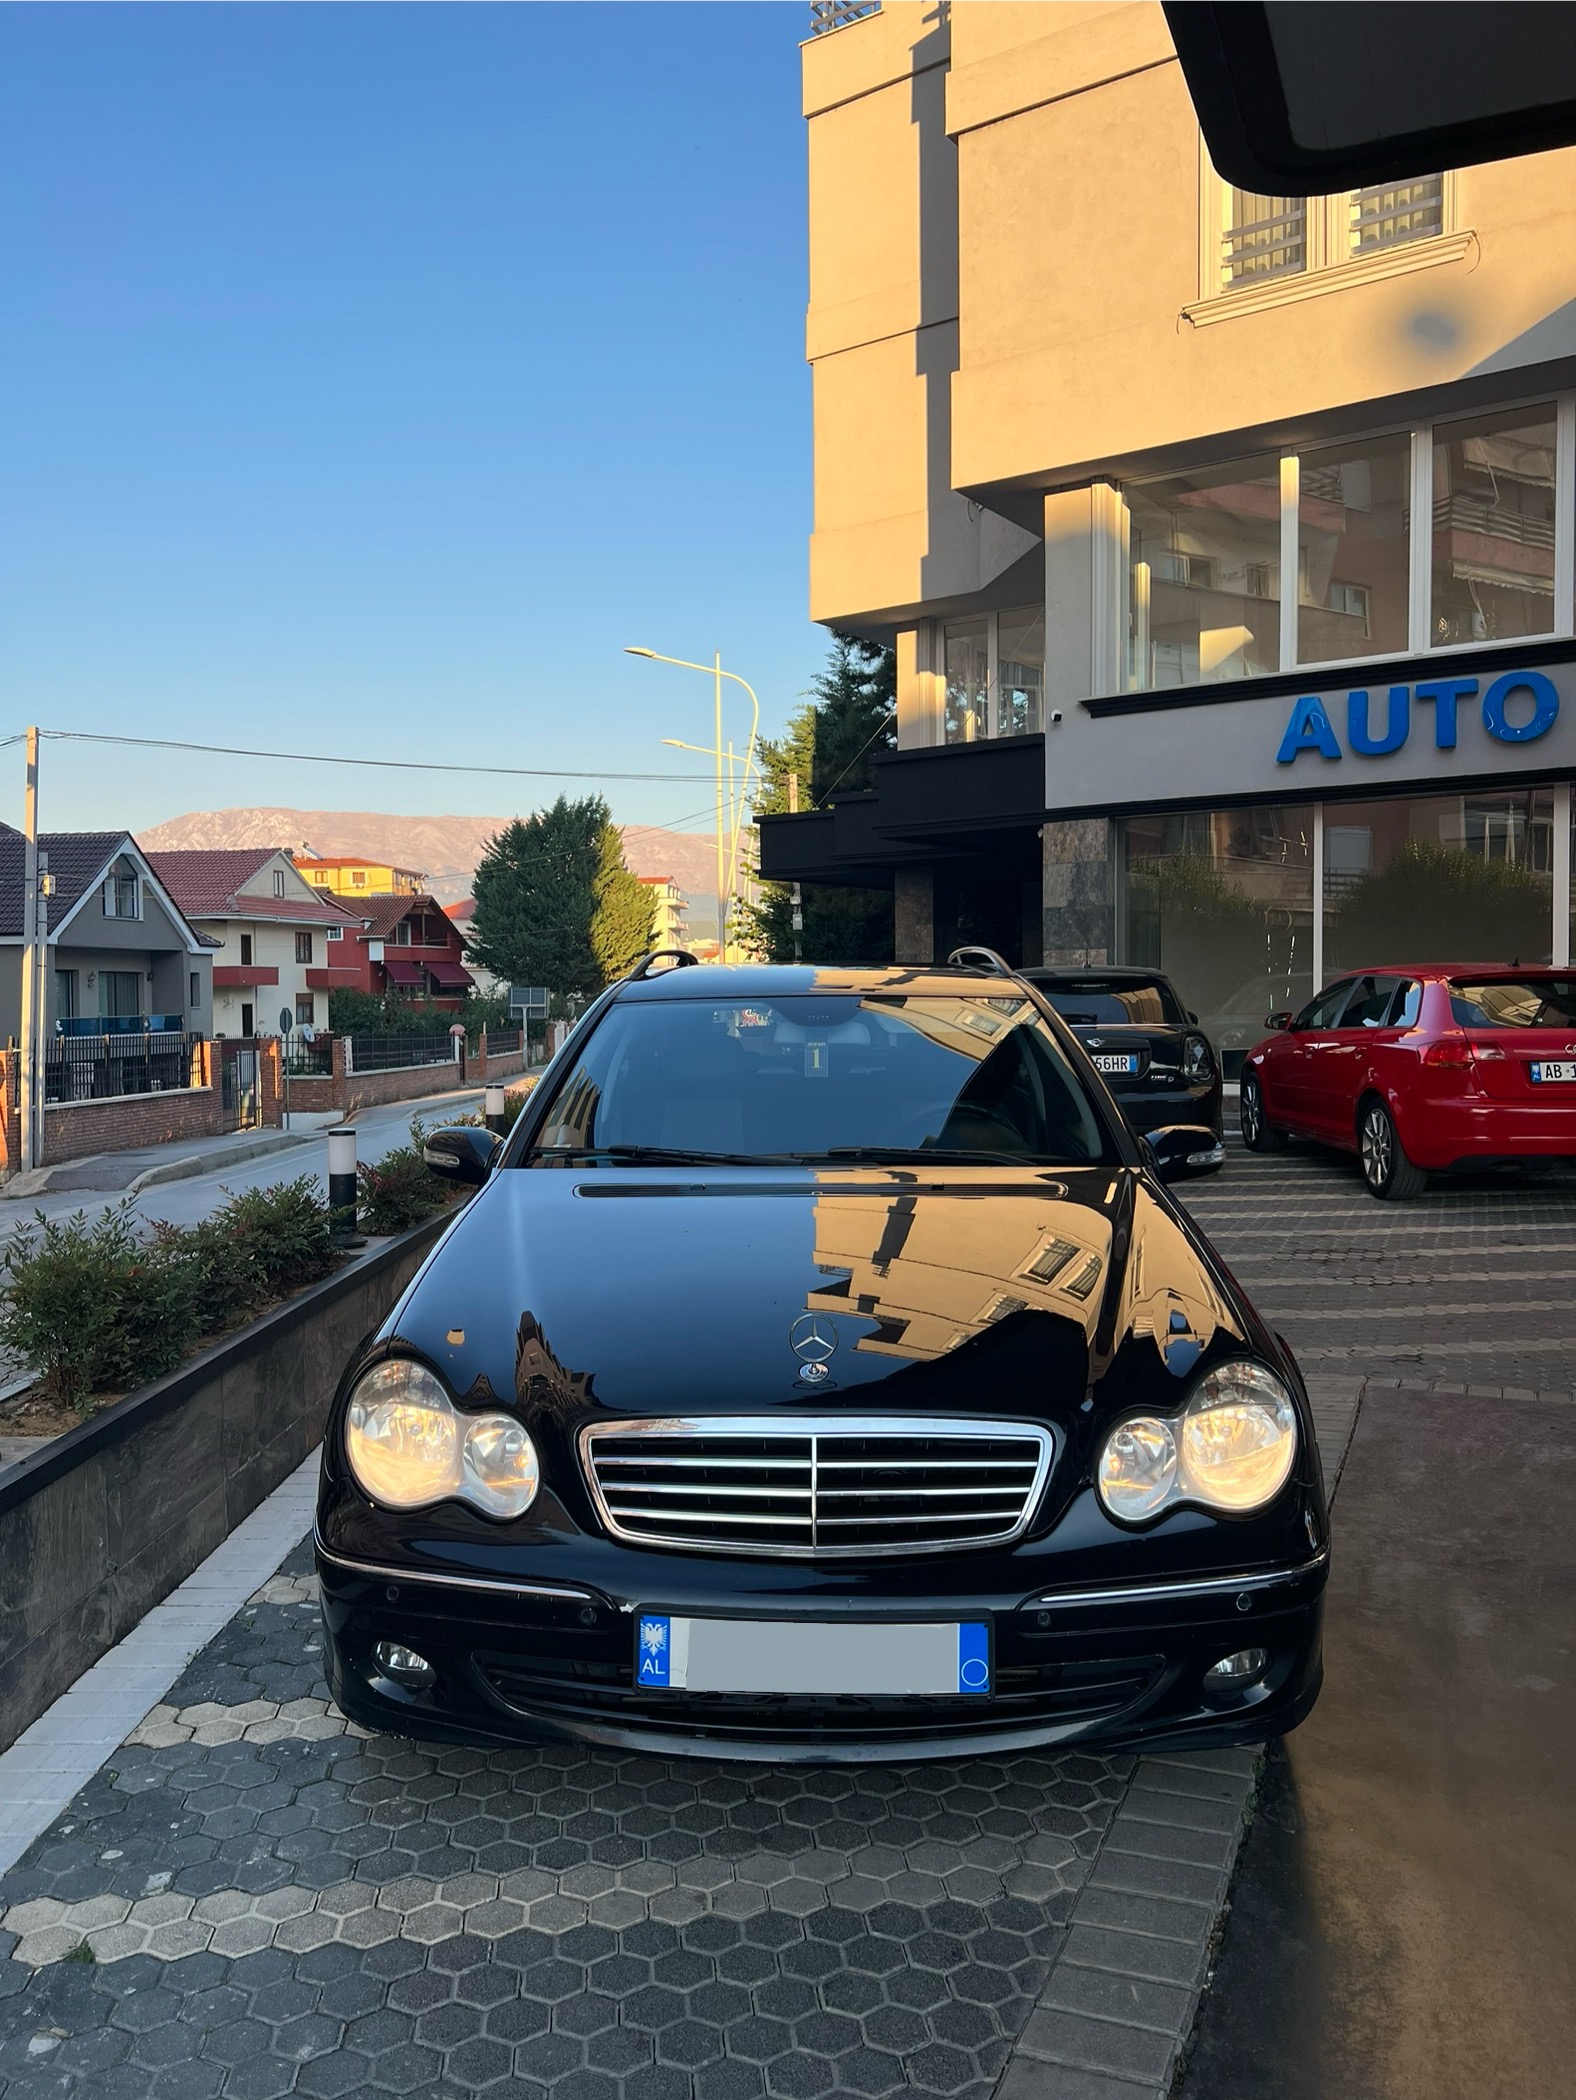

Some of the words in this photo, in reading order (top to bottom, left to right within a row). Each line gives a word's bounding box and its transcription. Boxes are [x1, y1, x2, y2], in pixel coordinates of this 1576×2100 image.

[1276, 671, 1559, 763] AUTO
[1546, 1064, 1563, 1079] AB
[642, 1659, 666, 1675] AL
